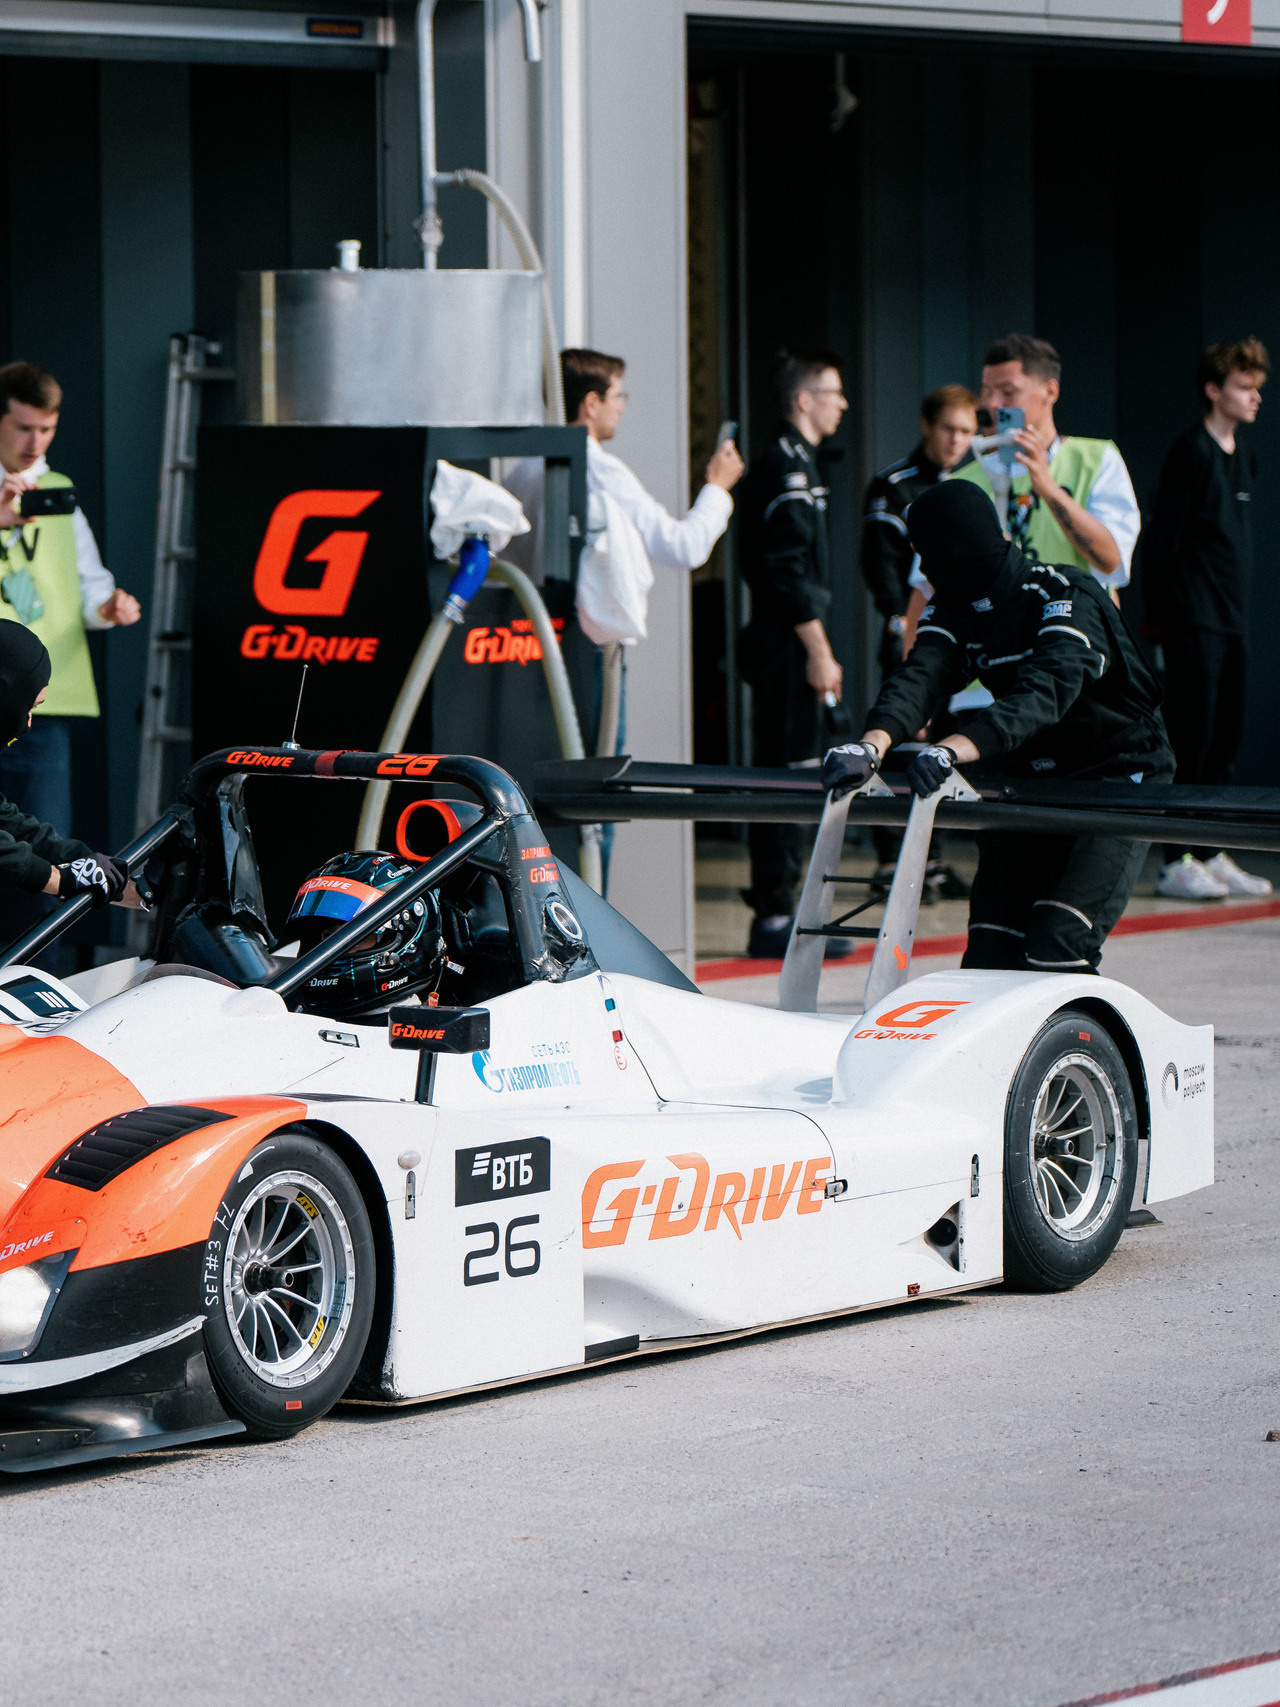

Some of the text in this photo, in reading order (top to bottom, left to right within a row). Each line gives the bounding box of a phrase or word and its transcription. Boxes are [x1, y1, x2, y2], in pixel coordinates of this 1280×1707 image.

[1042, 603, 1073, 617] OMP
[240, 624, 380, 666] G-DRIVE
[226, 751, 295, 768] G-DRIVE
[376, 754, 449, 776] 26
[305, 977, 339, 987] -DRIVE
[392, 1023, 446, 1040] G-DRIVE
[854, 1029, 938, 1041] G-DRIVE
[492, 1152, 533, 1191] ВТБ
[297, 1195, 319, 1218] ATS
[581, 1152, 831, 1249] G-DRIVE
[464, 1213, 541, 1287] 26
[311, 1316, 325, 1349] ATS
